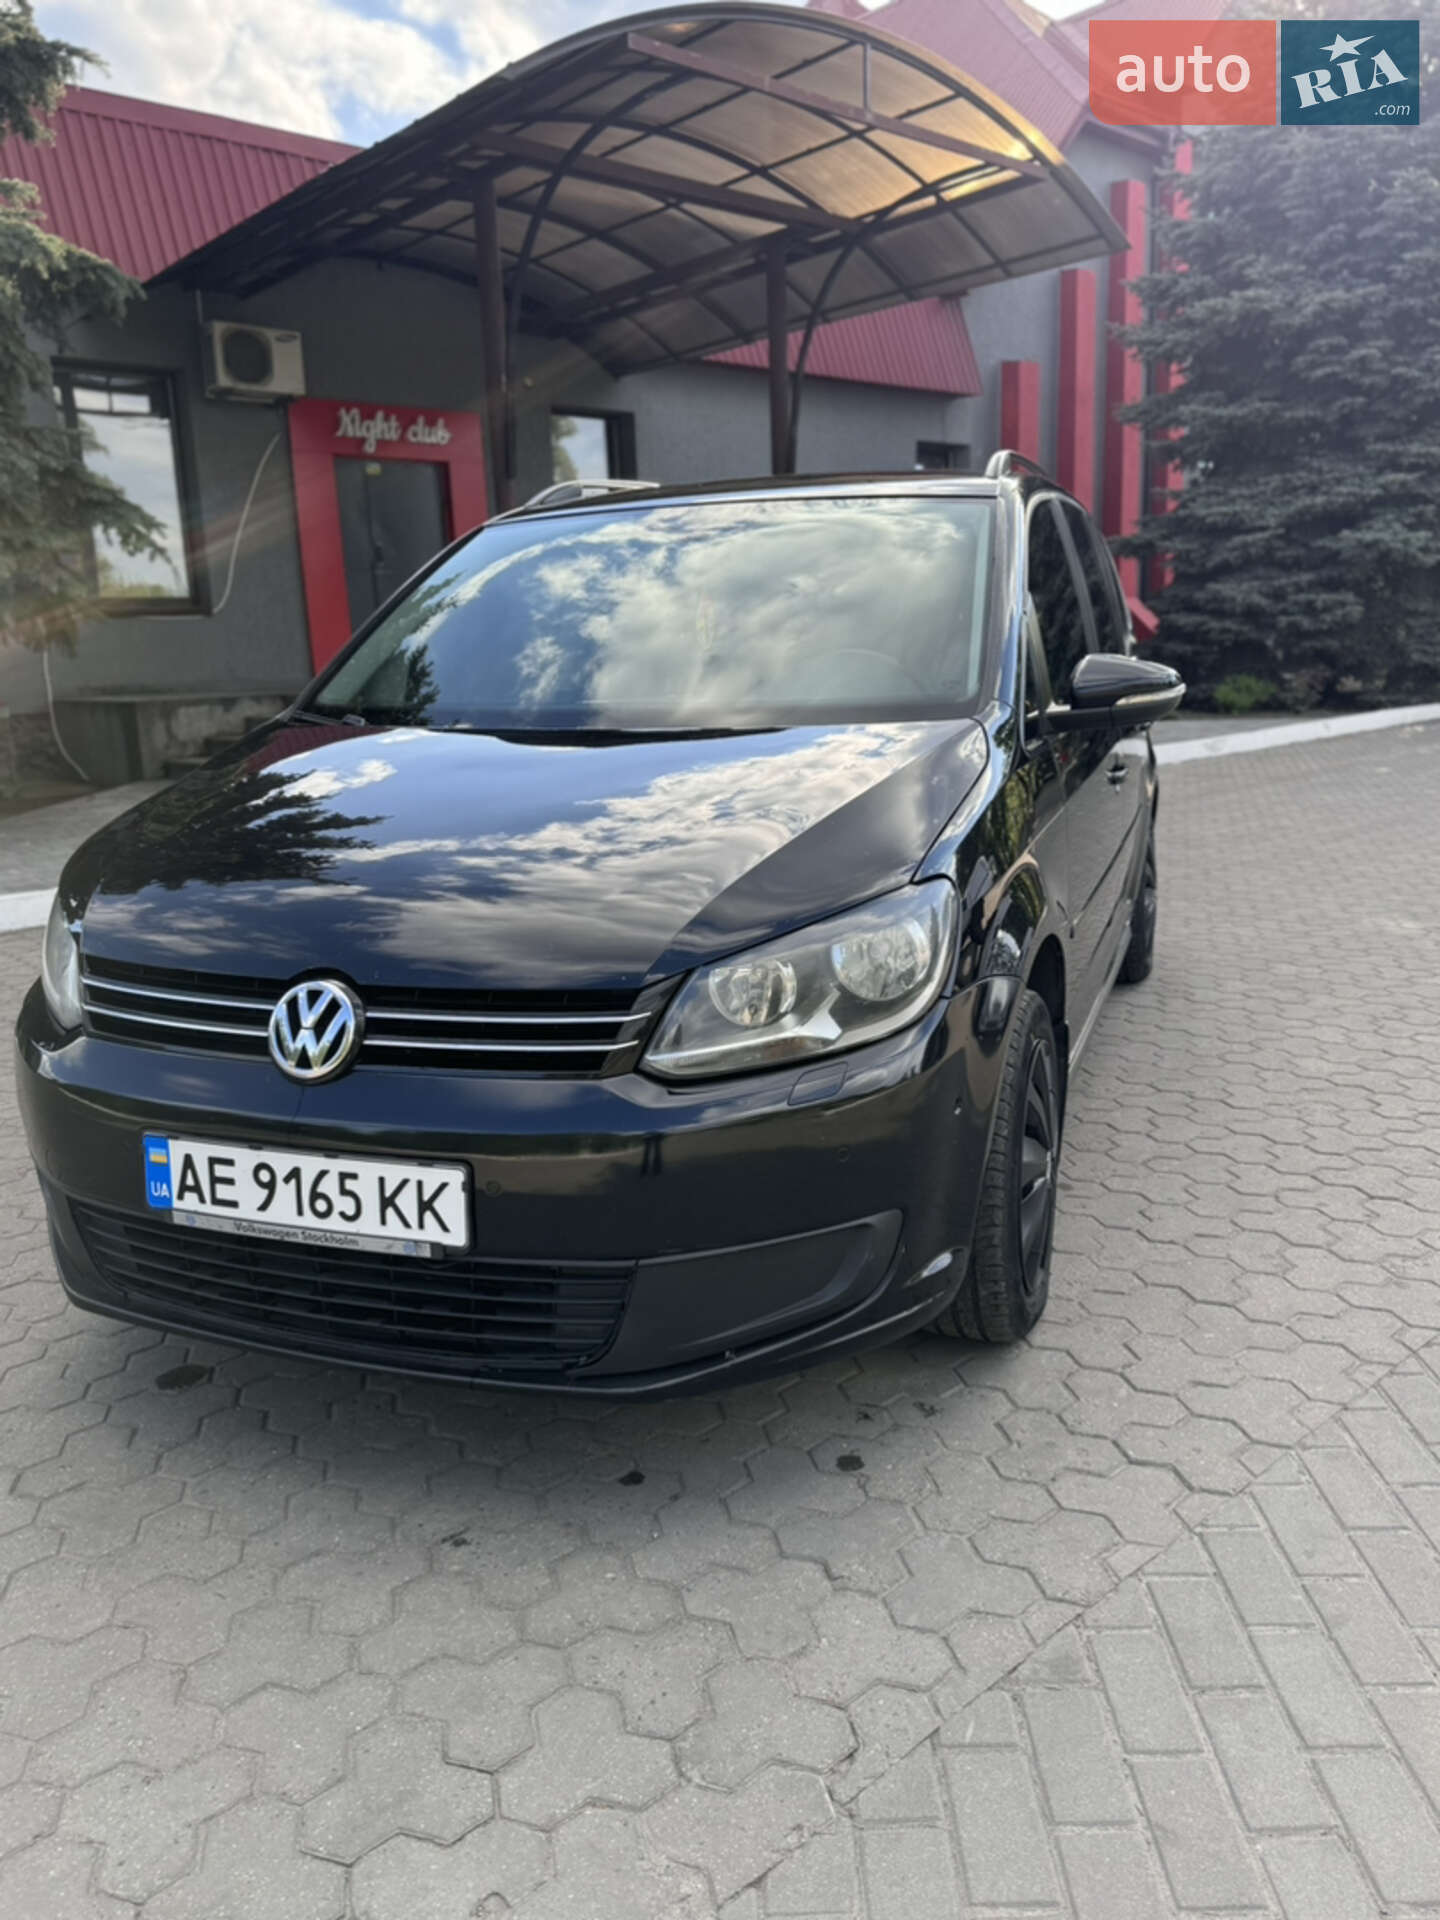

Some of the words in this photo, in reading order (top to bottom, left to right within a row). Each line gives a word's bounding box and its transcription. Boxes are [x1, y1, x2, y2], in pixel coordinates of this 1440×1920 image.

[336, 407, 401, 453] Night
[407, 415, 452, 445] club
[151, 1181, 170, 1198] UA
[177, 1153, 239, 1209] AE
[252, 1162, 362, 1222] 9165
[378, 1176, 450, 1232] KK
[233, 1220, 299, 1240] Volkswagen
[301, 1230, 359, 1247] Stockholm
